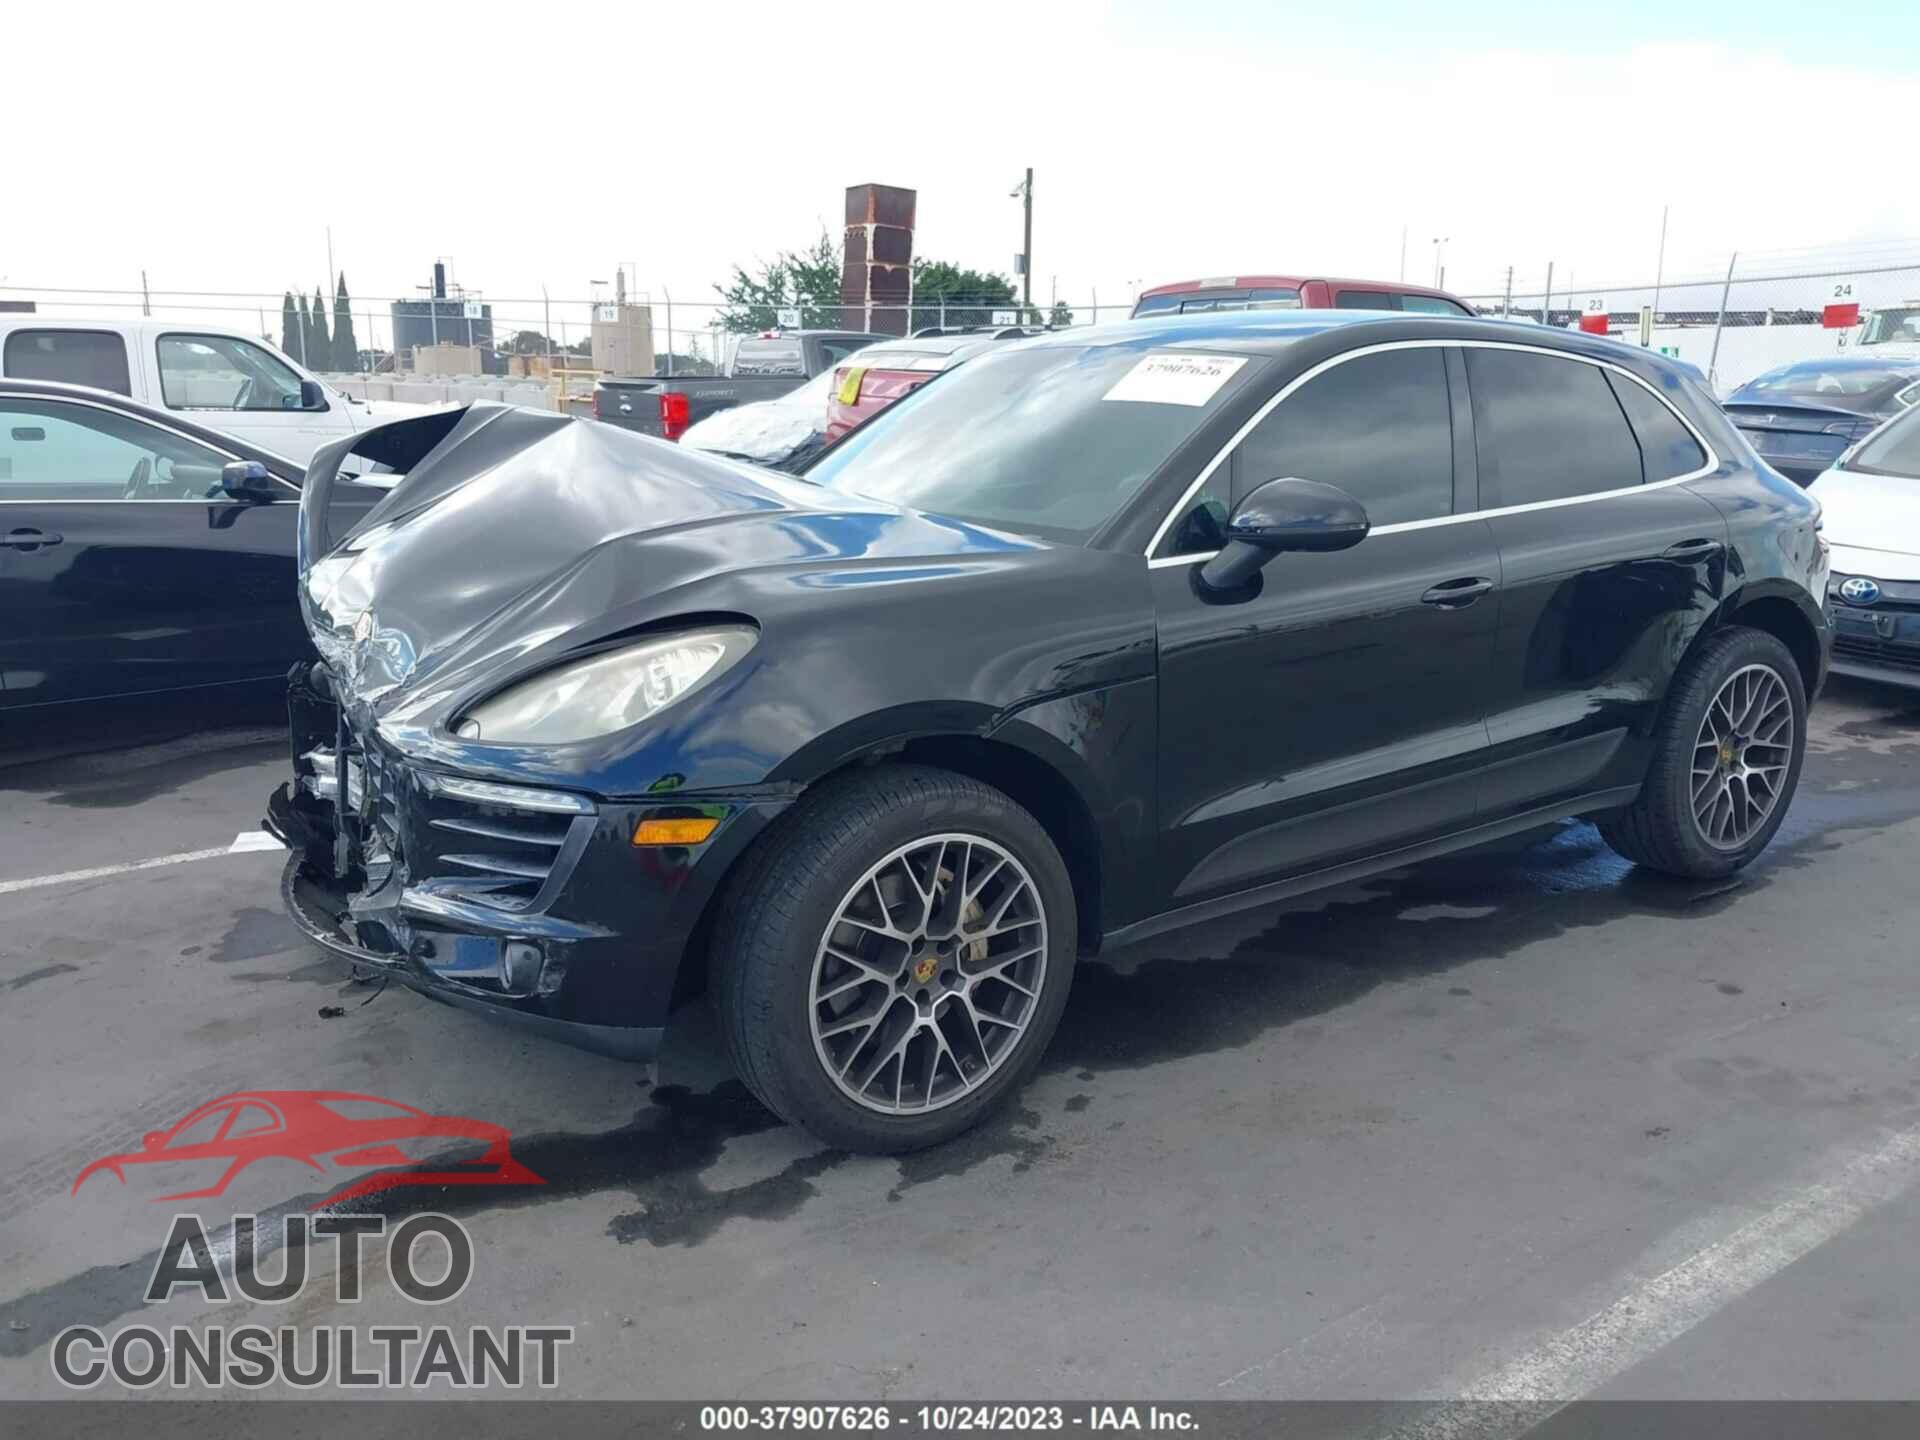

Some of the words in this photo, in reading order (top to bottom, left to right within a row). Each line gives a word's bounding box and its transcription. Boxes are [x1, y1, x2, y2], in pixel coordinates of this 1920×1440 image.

[1834, 284, 1852, 297] 24
[1589, 299, 1604, 310] 23
[783, 314, 794, 323] 20
